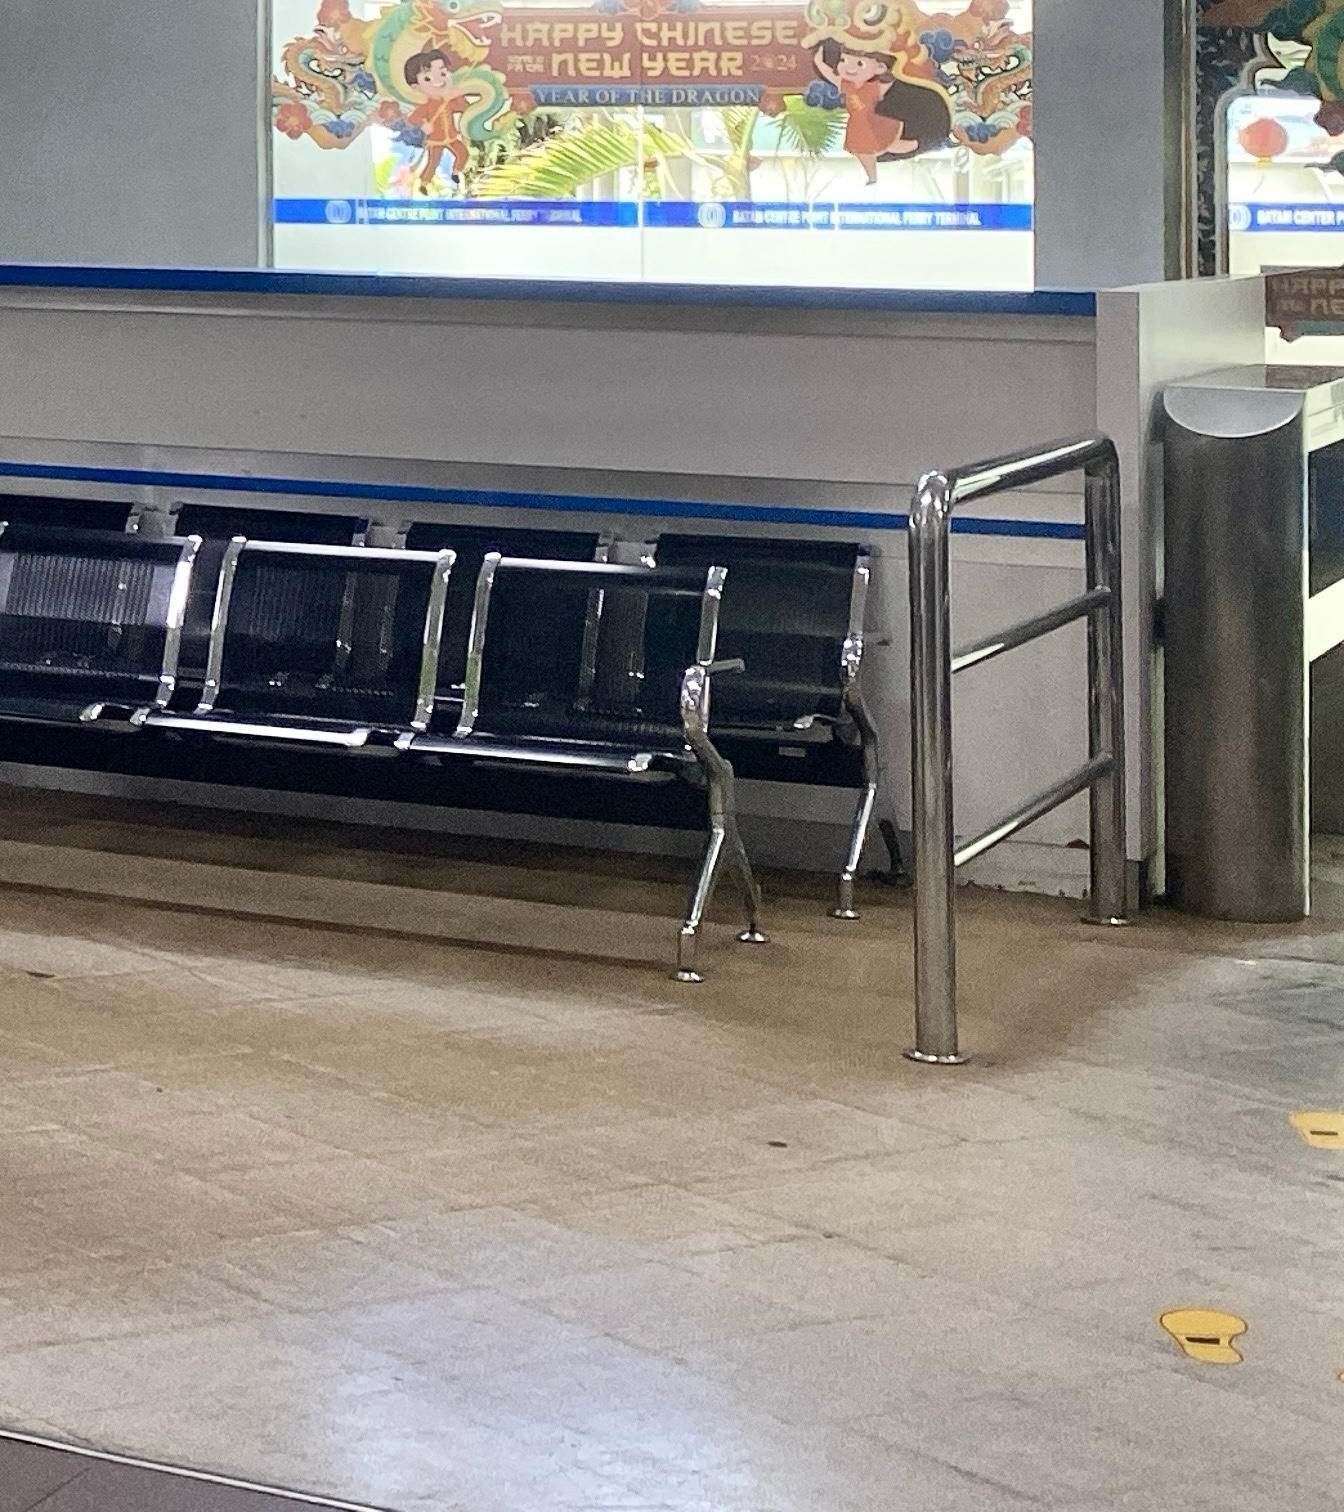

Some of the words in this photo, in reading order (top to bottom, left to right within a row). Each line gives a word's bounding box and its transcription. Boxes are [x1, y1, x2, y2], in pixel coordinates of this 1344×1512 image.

[500, 21, 624, 48] HAPPY
[635, 20, 799, 47] CHINESE
[551, 51, 631, 77] NEW
[641, 51, 744, 77] YEAR
[537, 88, 589, 104] YEAR
[602, 88, 623, 104] OF
[628, 88, 665, 104] THE
[671, 88, 761, 104] DRAGON
